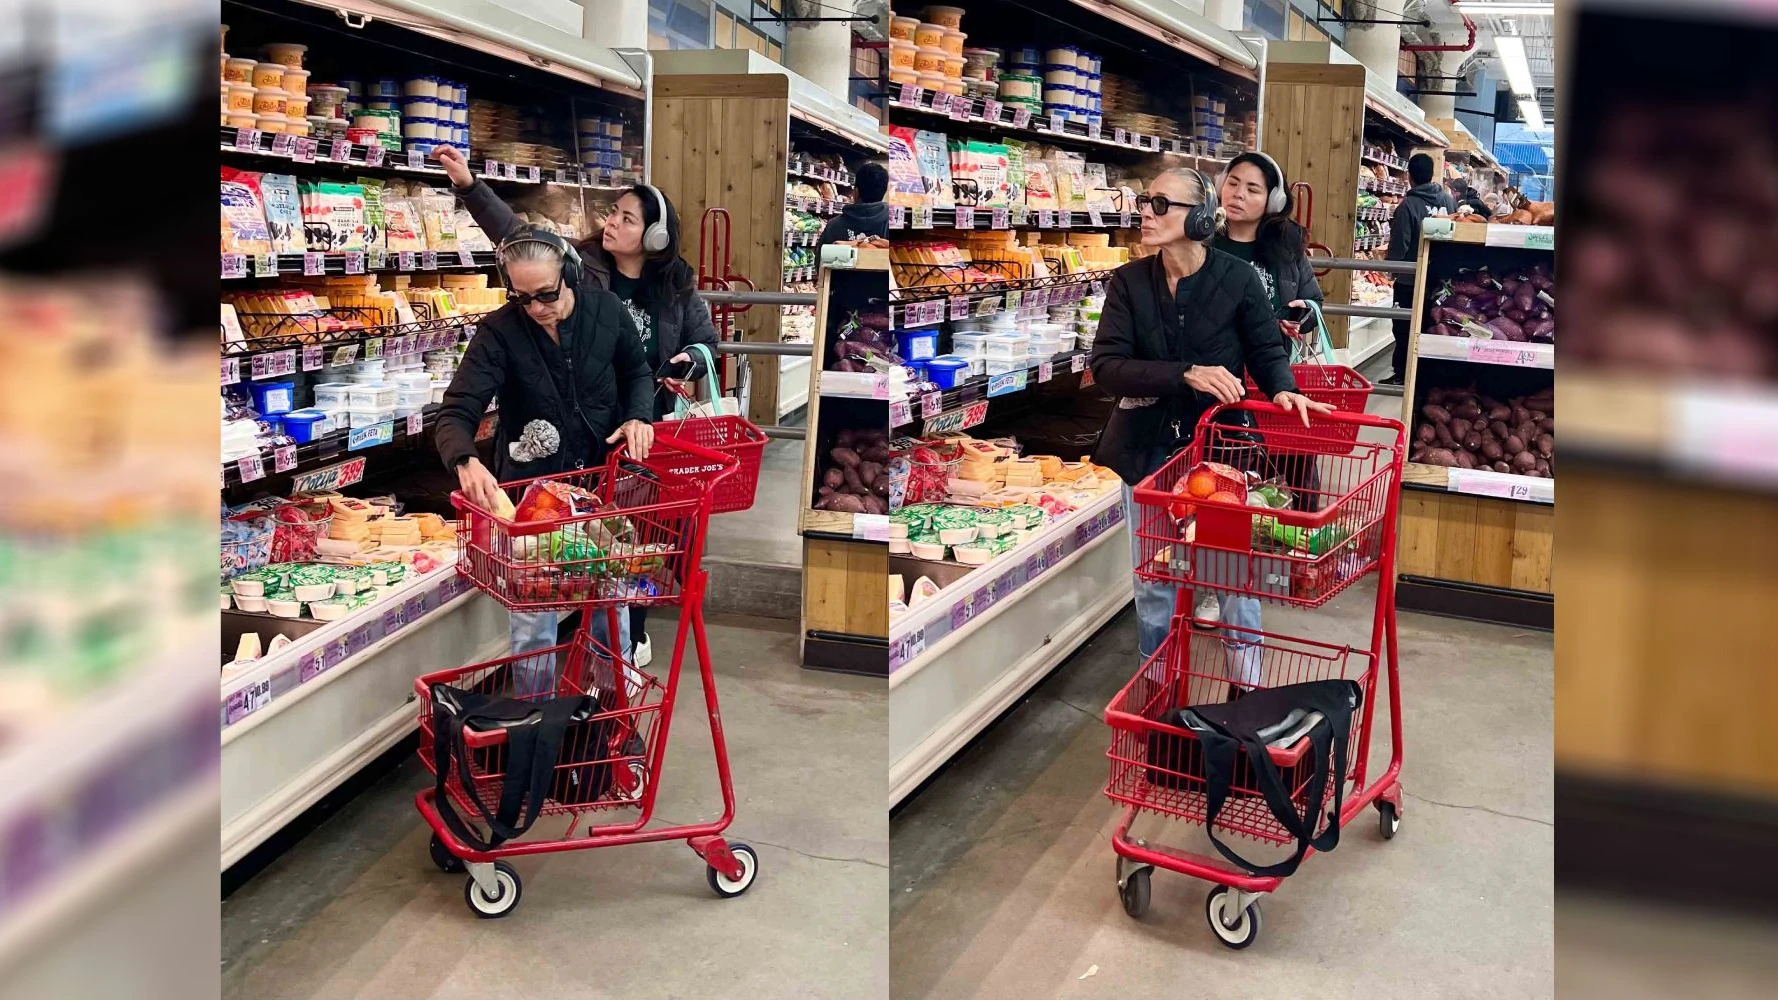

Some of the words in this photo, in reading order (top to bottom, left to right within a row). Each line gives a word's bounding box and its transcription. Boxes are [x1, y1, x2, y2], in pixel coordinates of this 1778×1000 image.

[963, 404, 986, 428] 399
[338, 459, 363, 486] 399
[669, 466, 700, 475] TRADER
[701, 464, 724, 472] JOE'S
